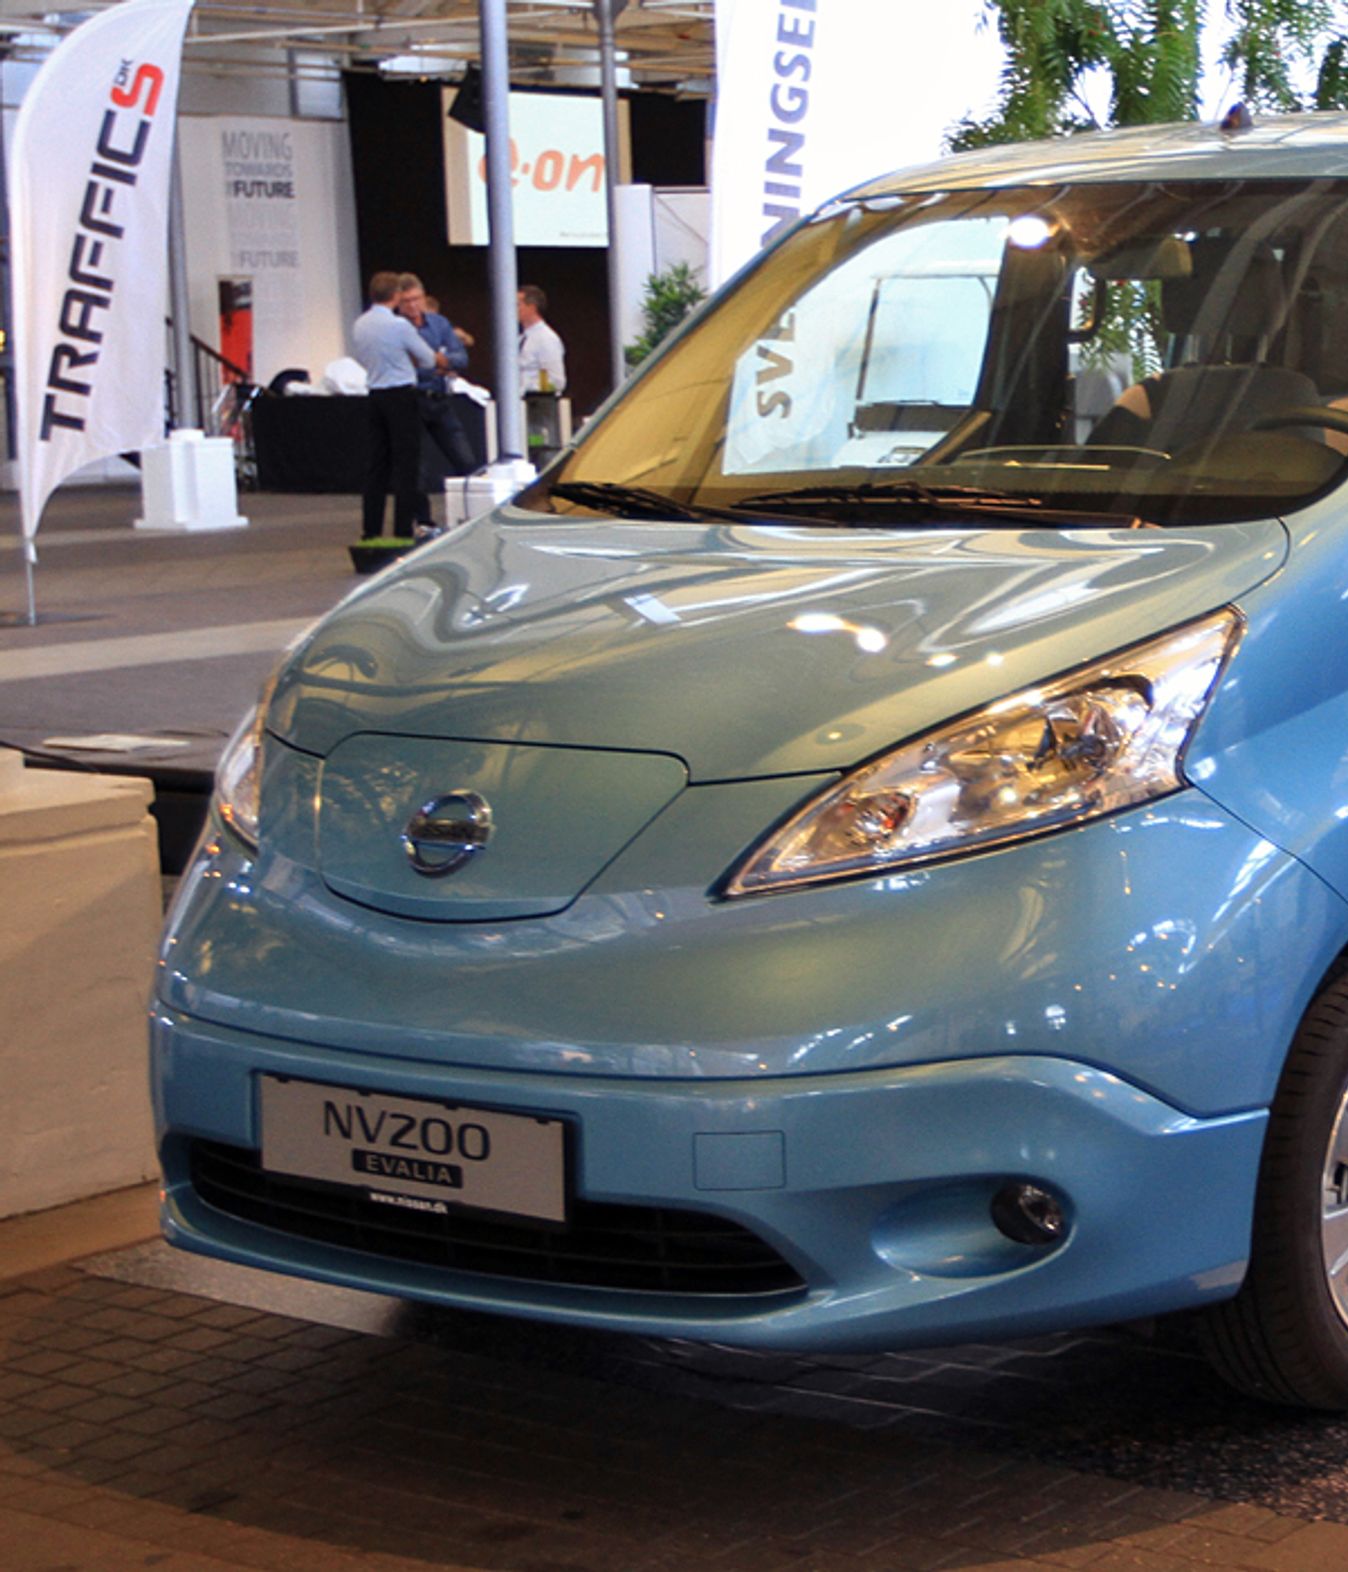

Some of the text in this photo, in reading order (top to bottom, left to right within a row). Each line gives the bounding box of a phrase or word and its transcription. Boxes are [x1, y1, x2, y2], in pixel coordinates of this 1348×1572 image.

[221, 130, 293, 160] MOVING
[233, 179, 296, 199] FUTURE
[323, 1099, 491, 1161] NV200
[364, 1153, 454, 1185] EVALIA
